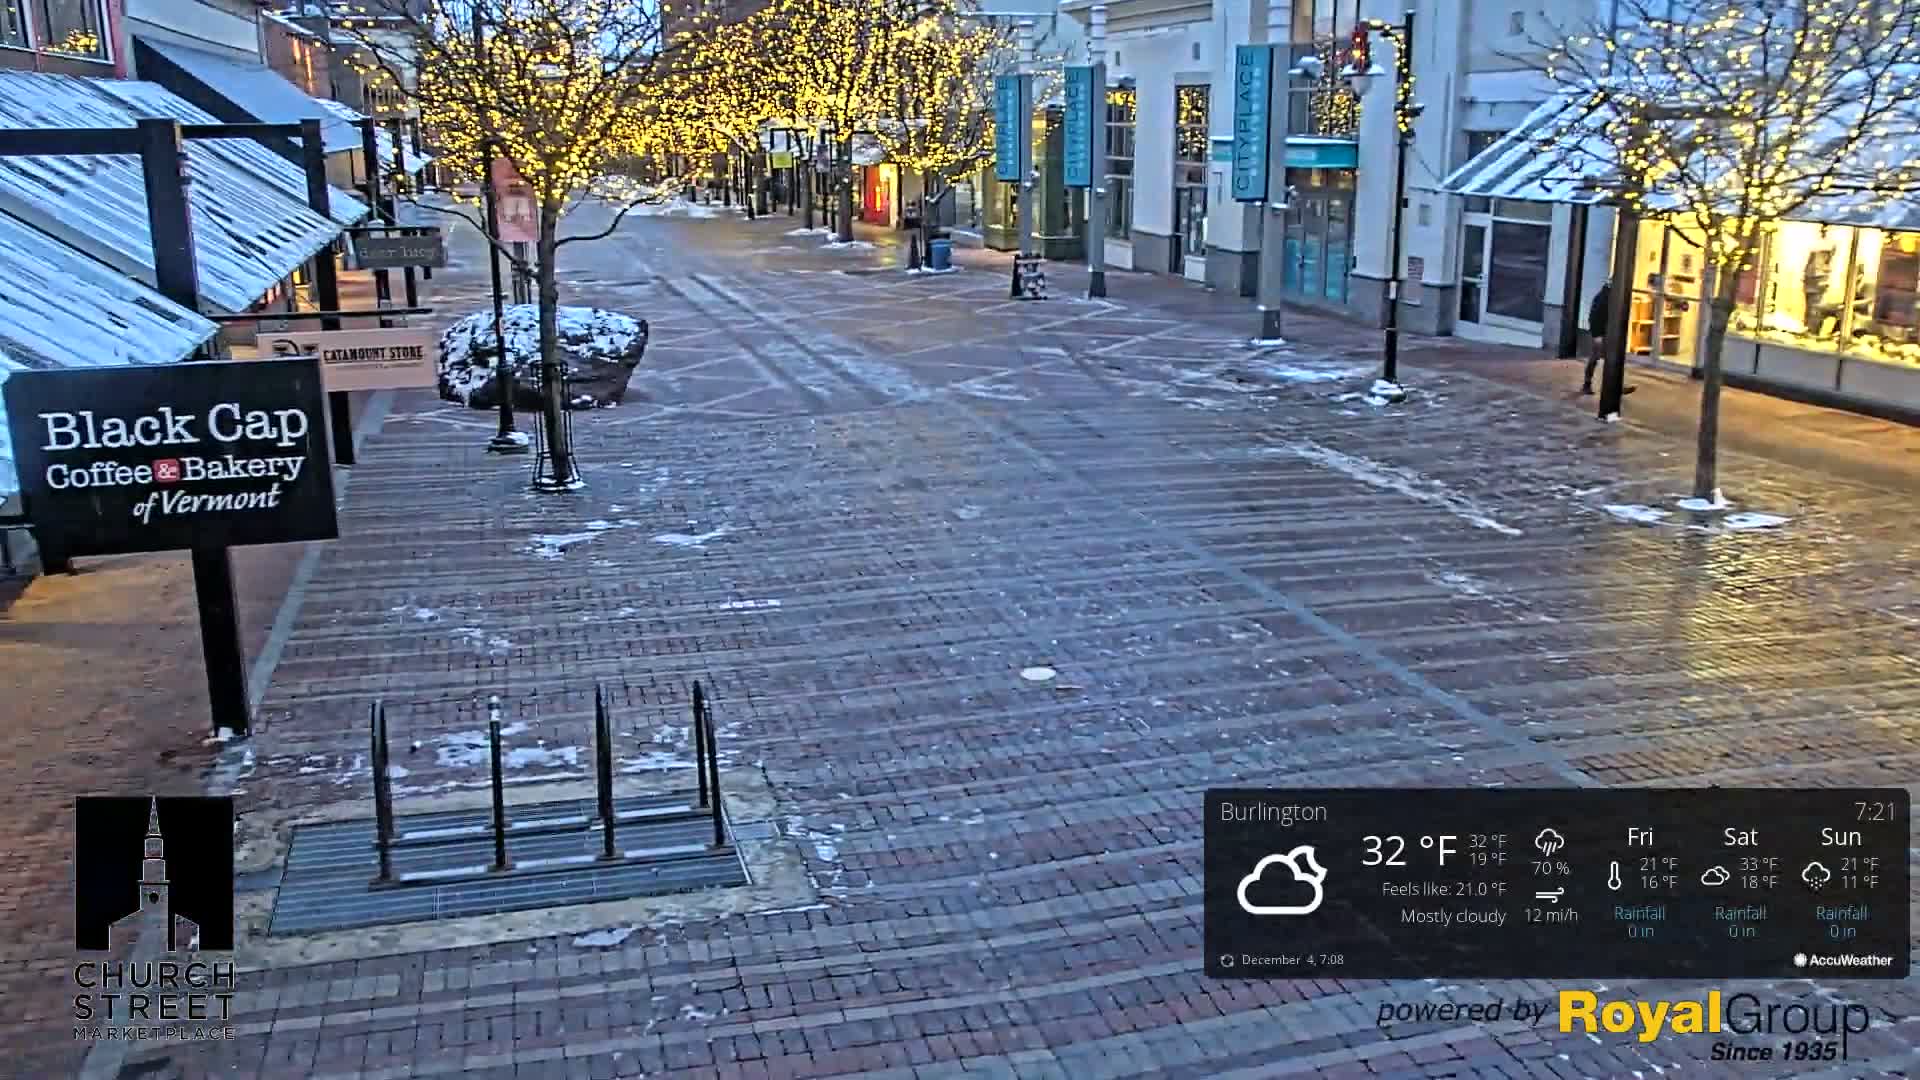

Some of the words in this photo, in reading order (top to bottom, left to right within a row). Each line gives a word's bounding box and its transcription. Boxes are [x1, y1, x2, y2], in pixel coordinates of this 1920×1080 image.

[1237, 52, 1253, 191] CITYPLACE
[323, 347, 385, 362] CATAMOUNT
[391, 345, 424, 360] STORE
[38, 407, 200, 450] Black
[208, 403, 308, 447] Cap
[47, 461, 152, 488] Coffee
[157, 463, 178, 479] &
[181, 455, 305, 481] Bakery
[133, 490, 161, 524] of
[161, 483, 283, 514] Vermont
